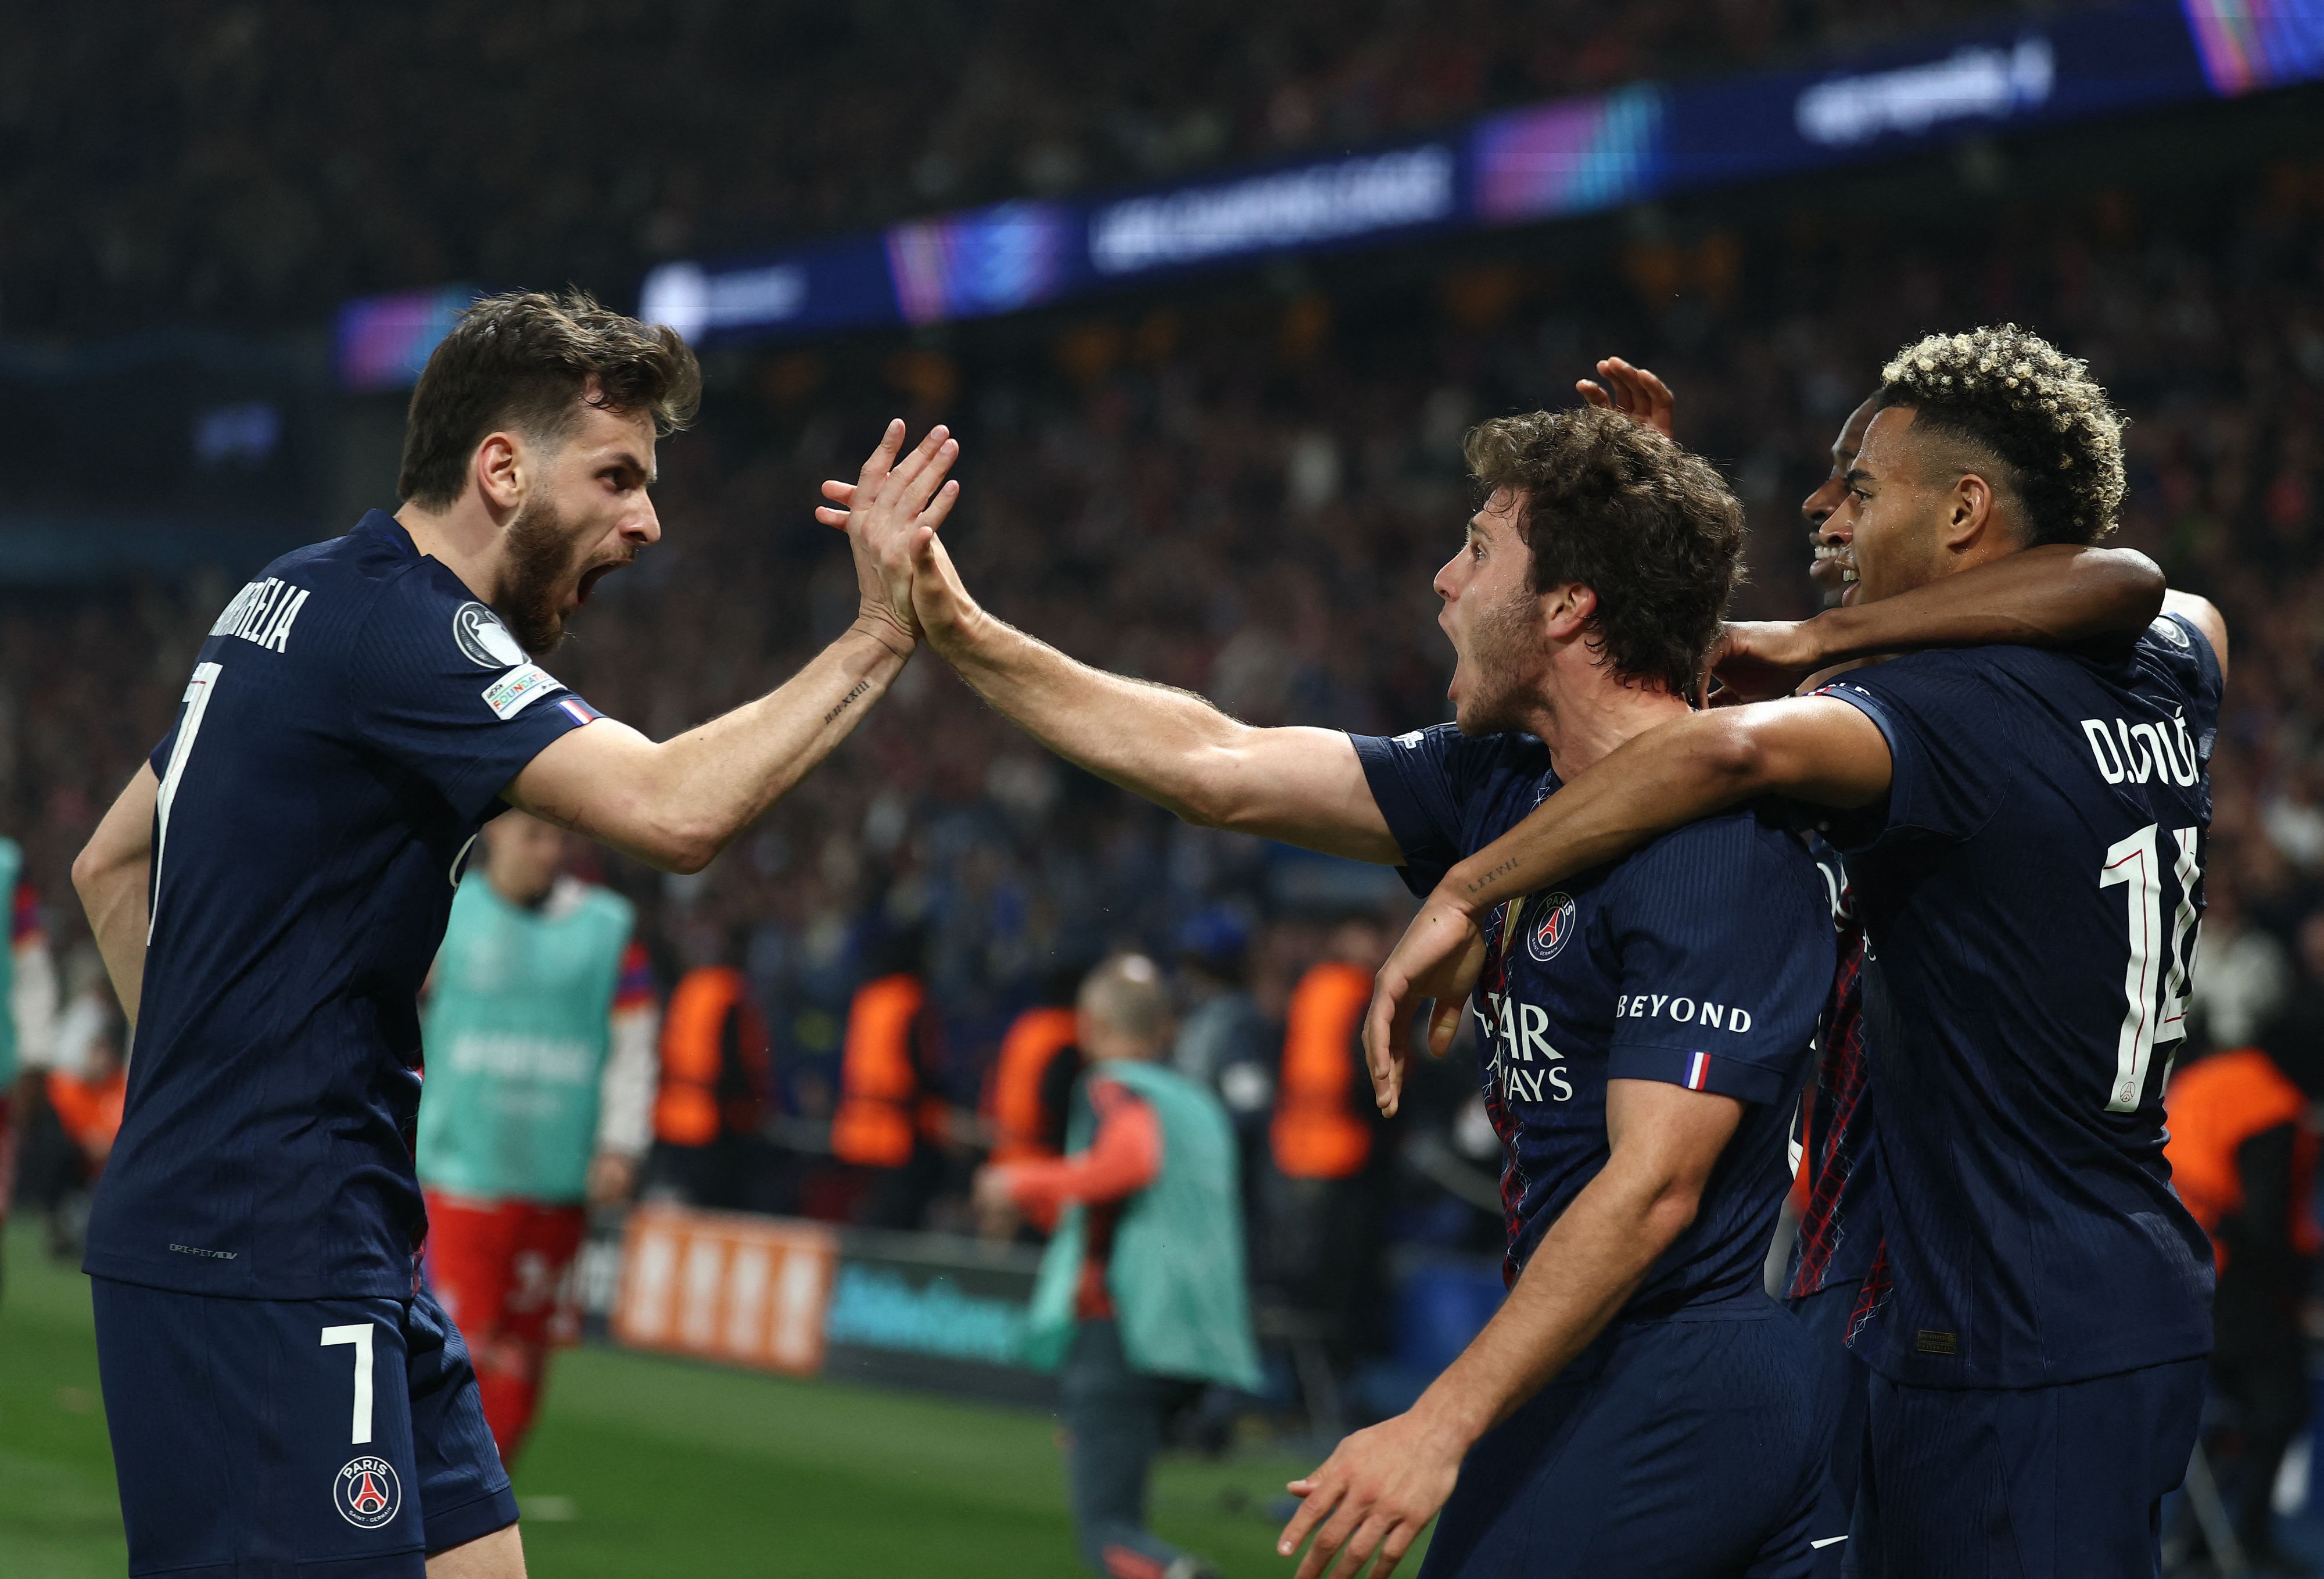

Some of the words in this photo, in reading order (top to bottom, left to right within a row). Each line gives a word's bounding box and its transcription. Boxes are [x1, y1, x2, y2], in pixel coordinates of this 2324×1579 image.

[493, 672, 548, 710] FOUNDATIO
[1545, 896, 1573, 916] PARIS
[2100, 822, 2202, 1112] 14
[1616, 994, 1752, 1033] BEYOND
[320, 1323, 374, 1444] 7
[343, 1459, 388, 1479] PARIS
